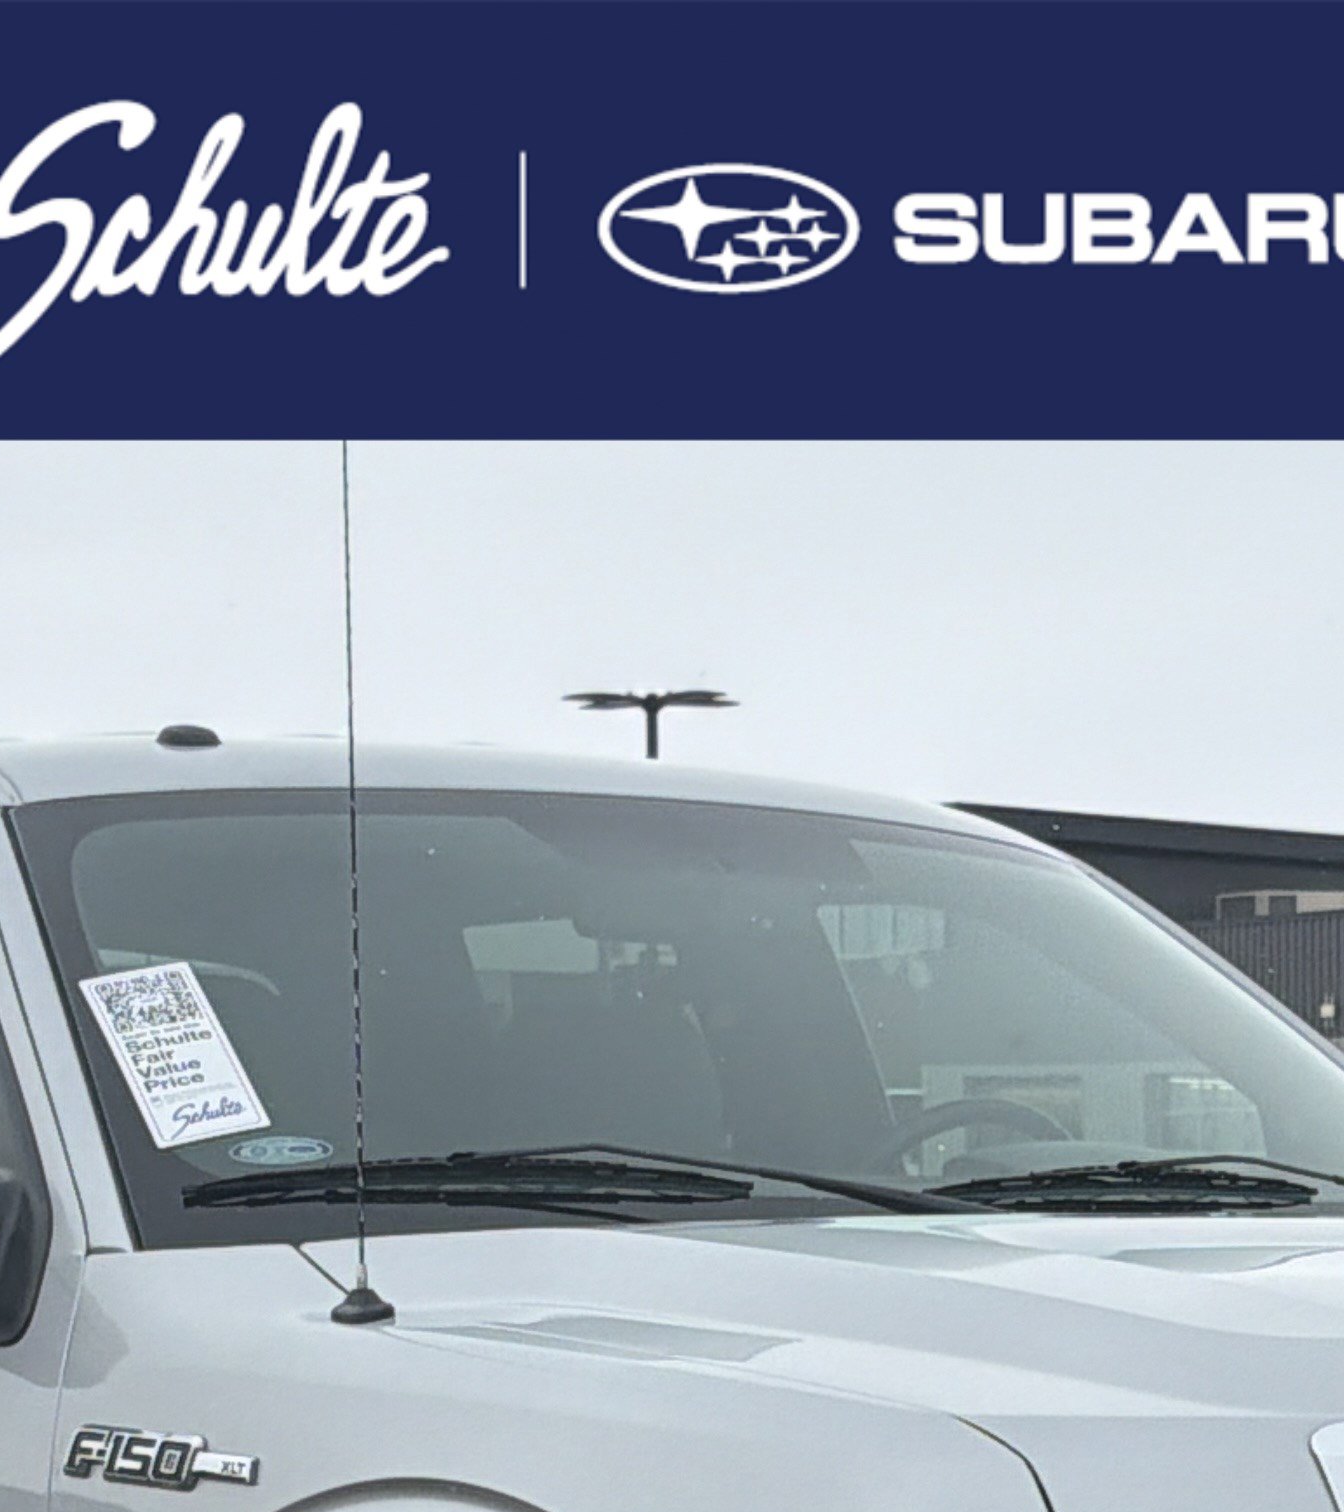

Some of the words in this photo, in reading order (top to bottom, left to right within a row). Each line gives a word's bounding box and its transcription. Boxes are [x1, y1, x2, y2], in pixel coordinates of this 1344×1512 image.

[125, 1030, 212, 1053] Schulte
[131, 1049, 175, 1066] Fair
[136, 1059, 202, 1079] Value
[143, 1073, 205, 1093] Price
[170, 1096, 246, 1141] Schulte
[220, 1460, 247, 1476] XLT
